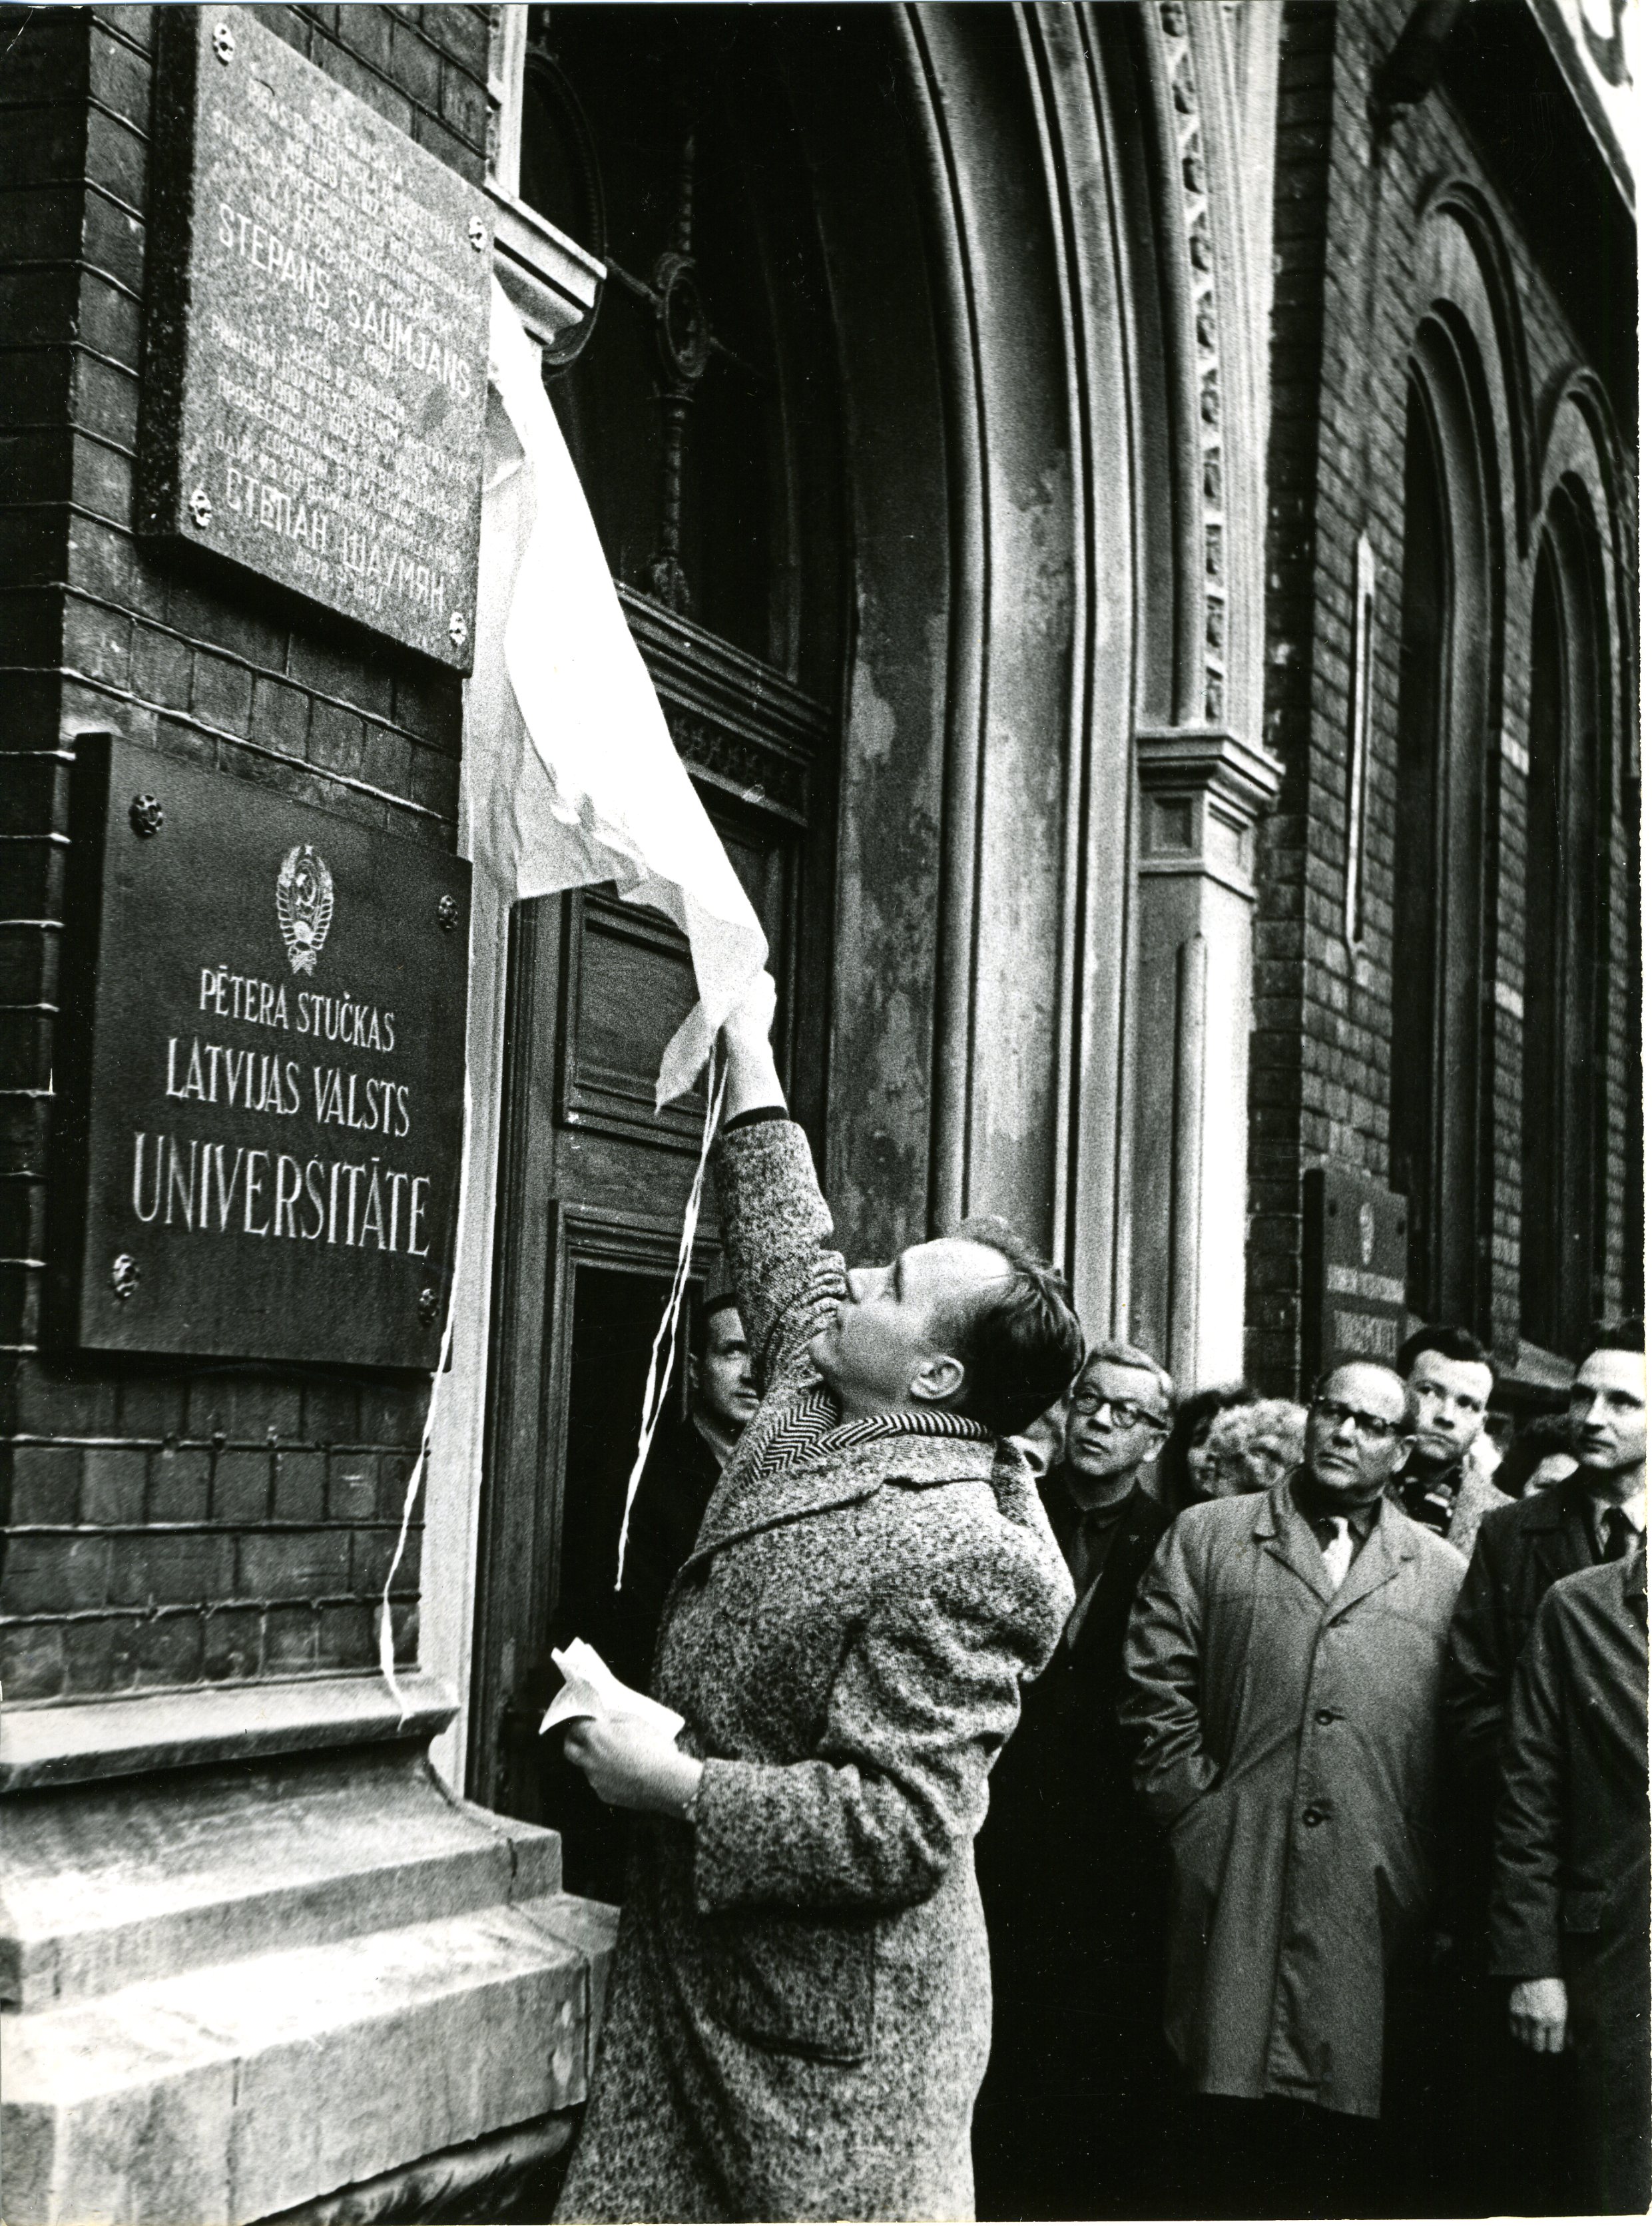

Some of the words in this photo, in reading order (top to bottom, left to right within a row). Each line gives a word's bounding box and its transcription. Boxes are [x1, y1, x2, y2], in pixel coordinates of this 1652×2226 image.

[219, 203, 330, 309] STEPANS
[226, 467, 326, 555] СТЕПАН
[343, 525, 445, 613] ШАУМЯН
[200, 965, 288, 1029] PĒTERA
[297, 991, 396, 1052] STUČKAS
[166, 1037, 300, 1115] LATVIJAS
[314, 1065, 410, 1137] VALSTS
[133, 1132, 431, 1257] UNIVERSITĀTE
